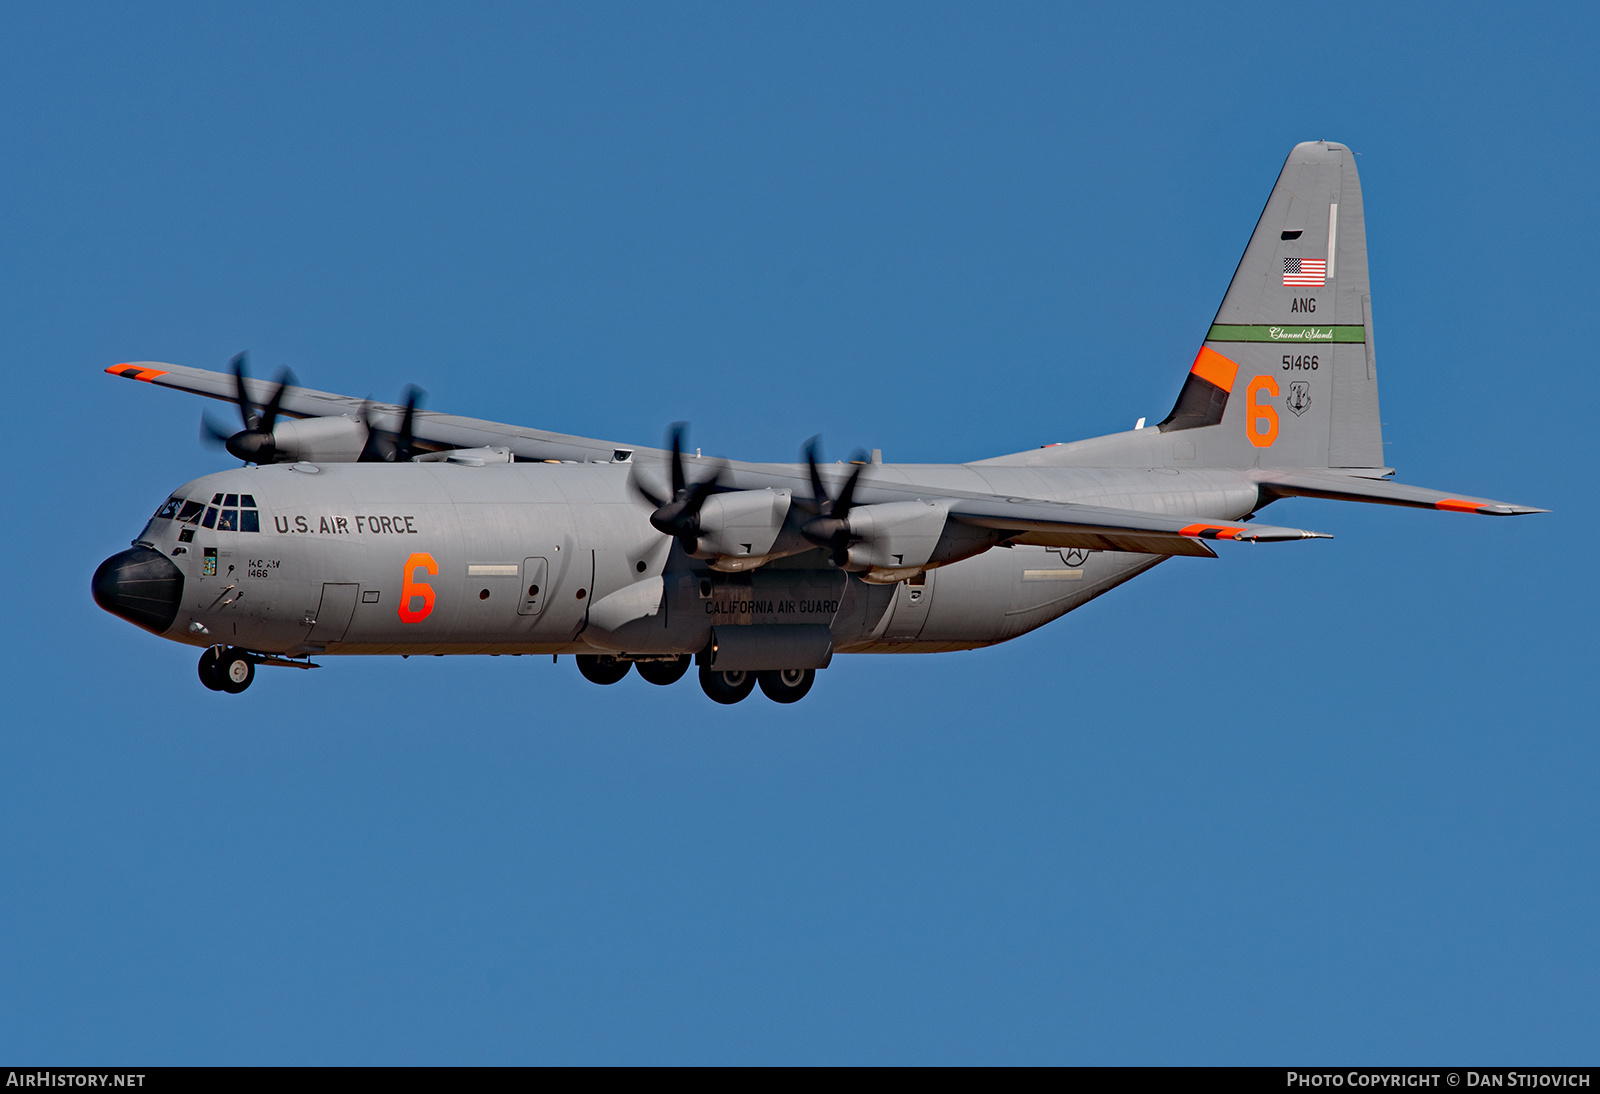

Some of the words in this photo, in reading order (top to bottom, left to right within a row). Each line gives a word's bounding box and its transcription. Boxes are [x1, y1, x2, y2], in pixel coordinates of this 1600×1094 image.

[1291, 298, 1316, 313] ANG
[1269, 327, 1305, 340] Channel
[1305, 328, 1332, 340] Islands
[1282, 355, 1319, 370] 51466
[1246, 375, 1279, 447] 6
[274, 515, 314, 534] U.S.
[319, 515, 349, 534] AIR
[355, 516, 418, 534] FORCE
[247, 569, 268, 578] 1466
[398, 552, 439, 624] 6
[705, 601, 774, 614] CALIFORNIA
[778, 600, 796, 613] AIR
[800, 600, 839, 613] GUARD
